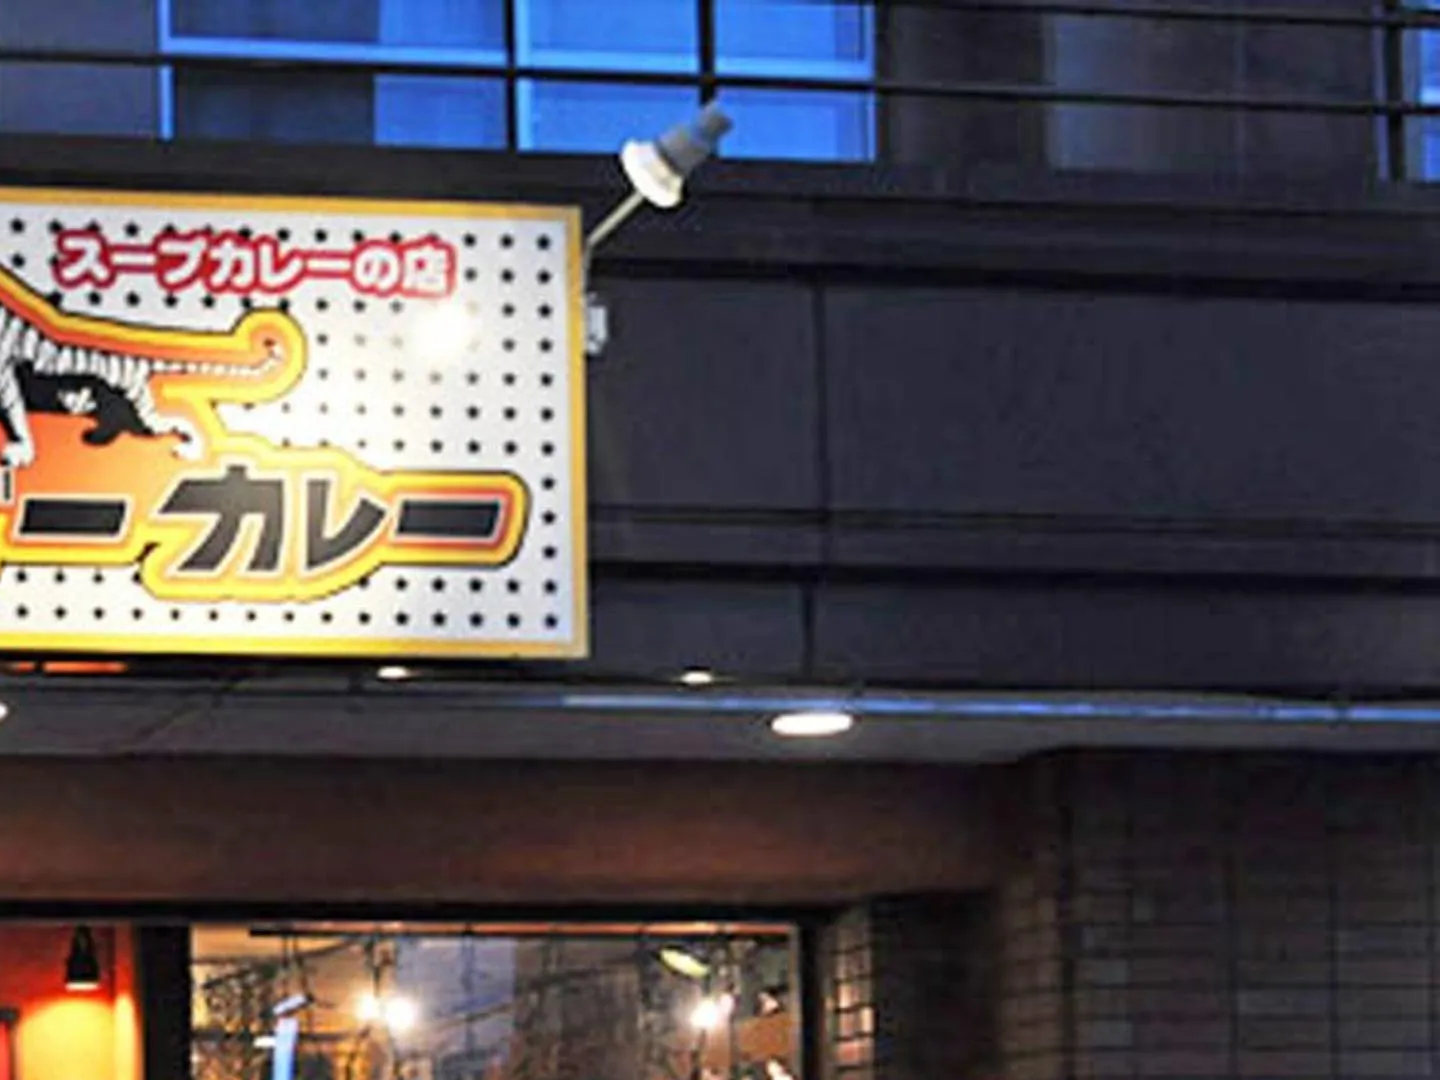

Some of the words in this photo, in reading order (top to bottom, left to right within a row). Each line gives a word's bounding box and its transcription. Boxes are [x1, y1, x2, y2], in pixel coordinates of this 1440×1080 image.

[59, 234, 453, 295] スープカレーの店
